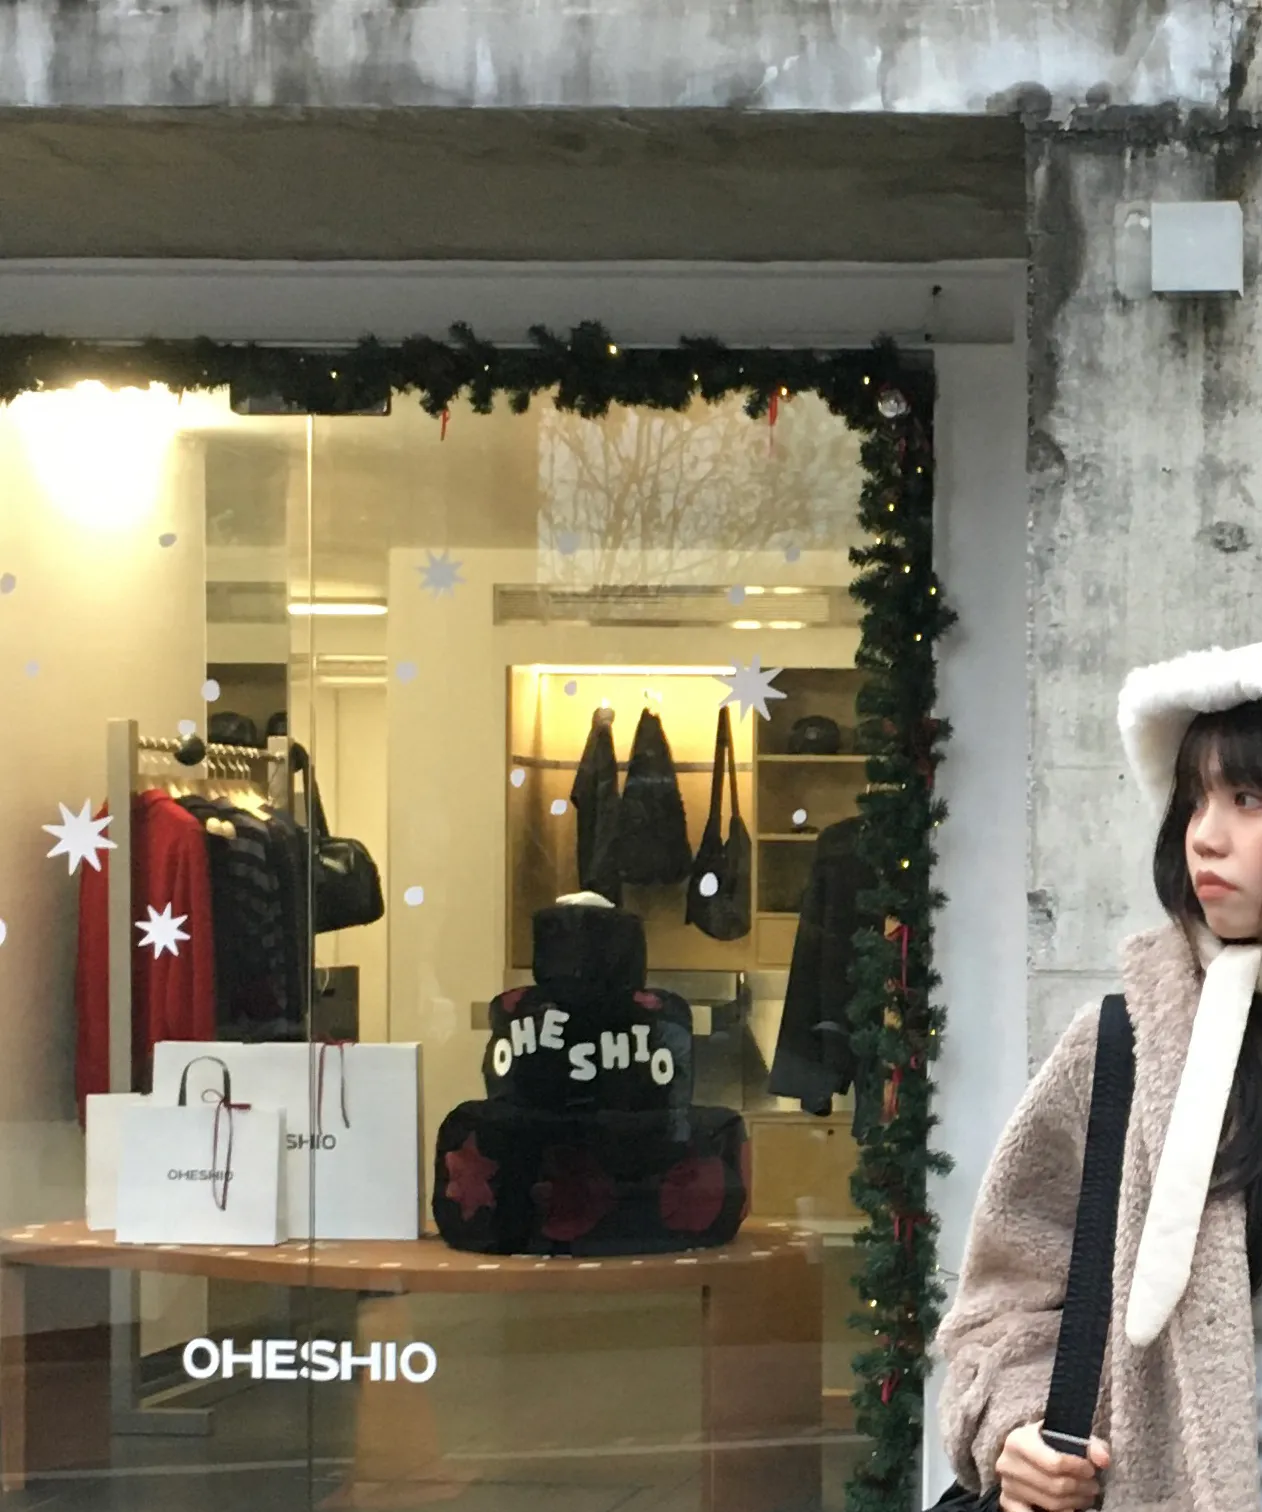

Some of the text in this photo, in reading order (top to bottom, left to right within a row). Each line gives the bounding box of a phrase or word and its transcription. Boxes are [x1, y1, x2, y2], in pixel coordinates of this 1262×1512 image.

[493, 1008, 675, 1086] OHE SHIO
[167, 1168, 234, 1182] OHESHIO
[183, 1337, 438, 1384] OHESHIO
